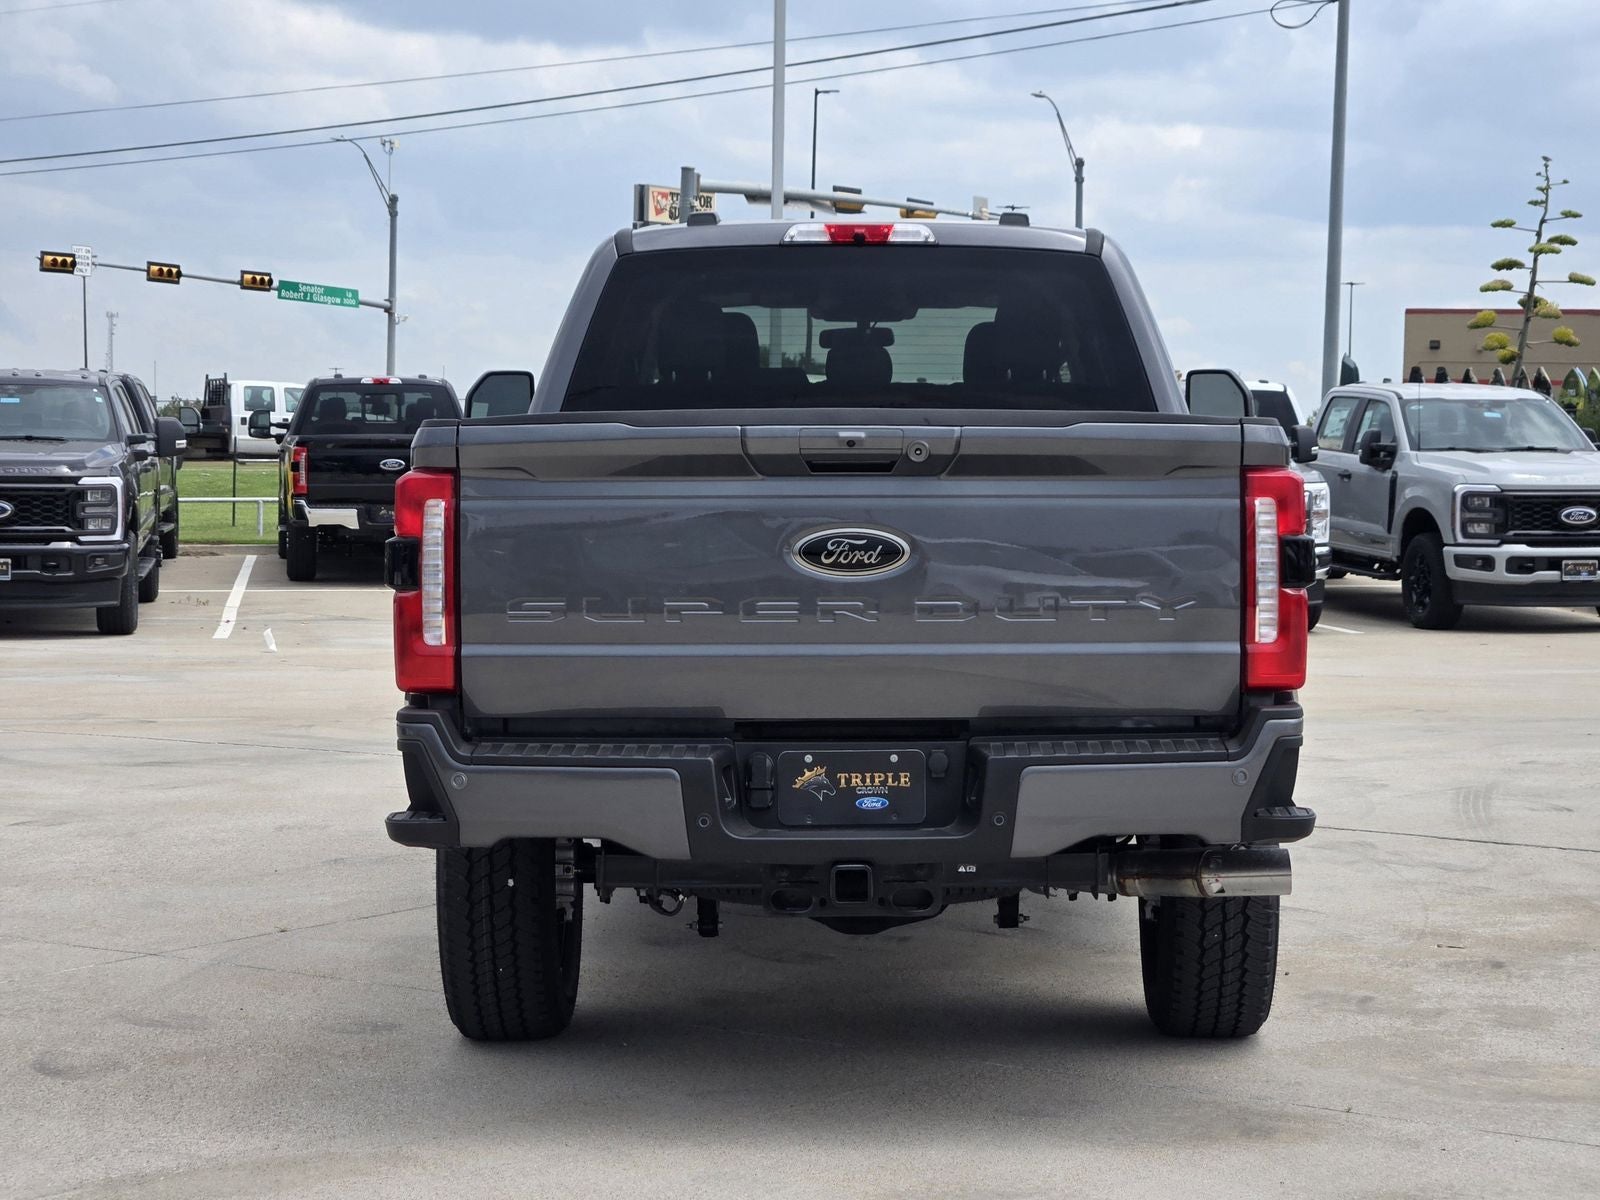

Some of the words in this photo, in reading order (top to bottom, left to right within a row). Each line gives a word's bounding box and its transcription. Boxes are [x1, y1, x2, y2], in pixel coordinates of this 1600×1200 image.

[281, 289, 304, 300] Robert
[306, 293, 310, 301] J
[312, 294, 341, 304] Glasgow
[298, 284, 325, 294] Senator
[1569, 510, 1589, 521] Ford
[820, 538, 883, 564] Ford
[506, 597, 878, 623] SUPER
[914, 595, 1197, 623] DUTY
[836, 772, 911, 788] TRIPLE
[861, 799, 882, 808] Ford
